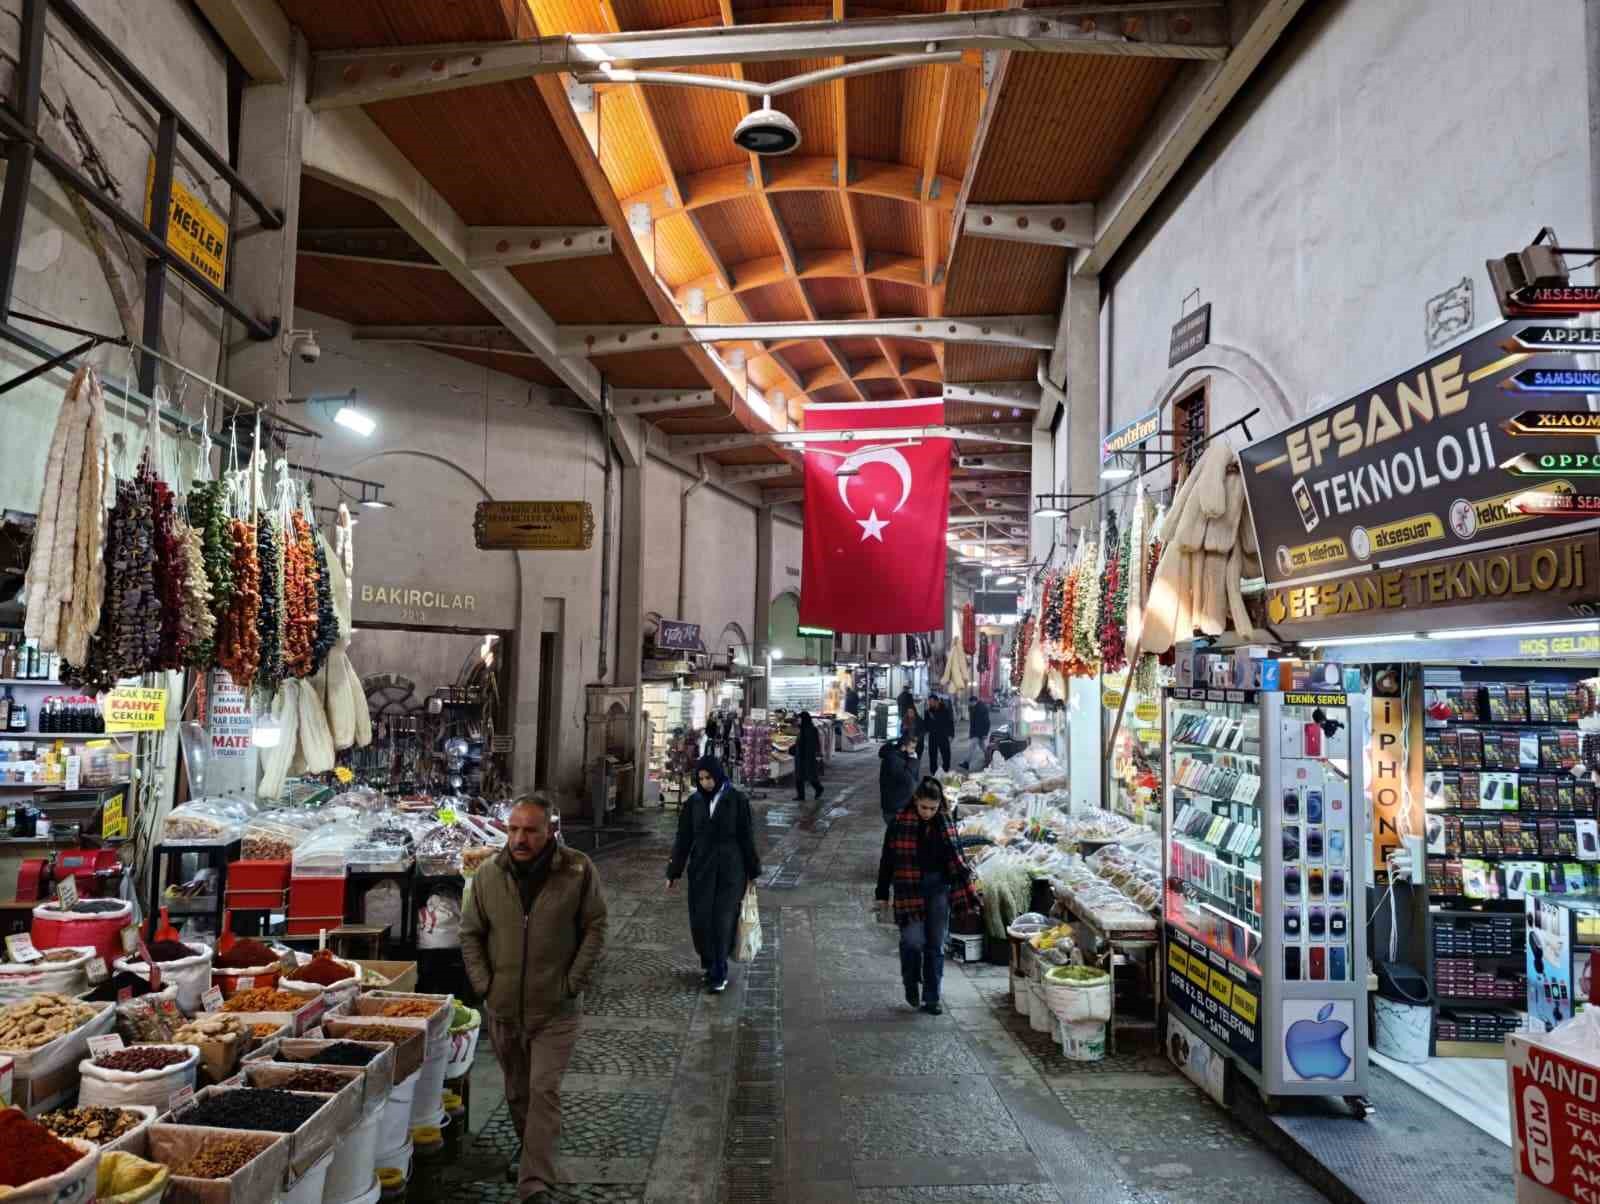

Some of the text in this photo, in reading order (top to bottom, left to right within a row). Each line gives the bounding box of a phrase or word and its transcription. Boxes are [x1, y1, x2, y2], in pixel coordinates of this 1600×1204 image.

[1541, 329, 1600, 342] APPLE
[1535, 371, 1600, 385] SAMSUNG
[1286, 354, 1471, 476] EFSANE
[1375, 520, 1432, 548] aksesuar
[1308, 543, 1345, 562] telefonu
[361, 584, 475, 610] BAKIRCILAR
[1287, 572, 1405, 618] EFSANE
[112, 700, 160, 711] KAHVE
[213, 705, 241, 715] SUMAK
[1190, 1004, 1206, 1025] ALIM
[1209, 1020, 1230, 1044] SATIM
[1205, 998, 1218, 1015] CEP
[1218, 1006, 1255, 1044] TELEFONU
[1522, 1056, 1598, 1103] NANO
[1529, 1099, 1550, 1167] TÜM
[1567, 1121, 1600, 1146] TA
